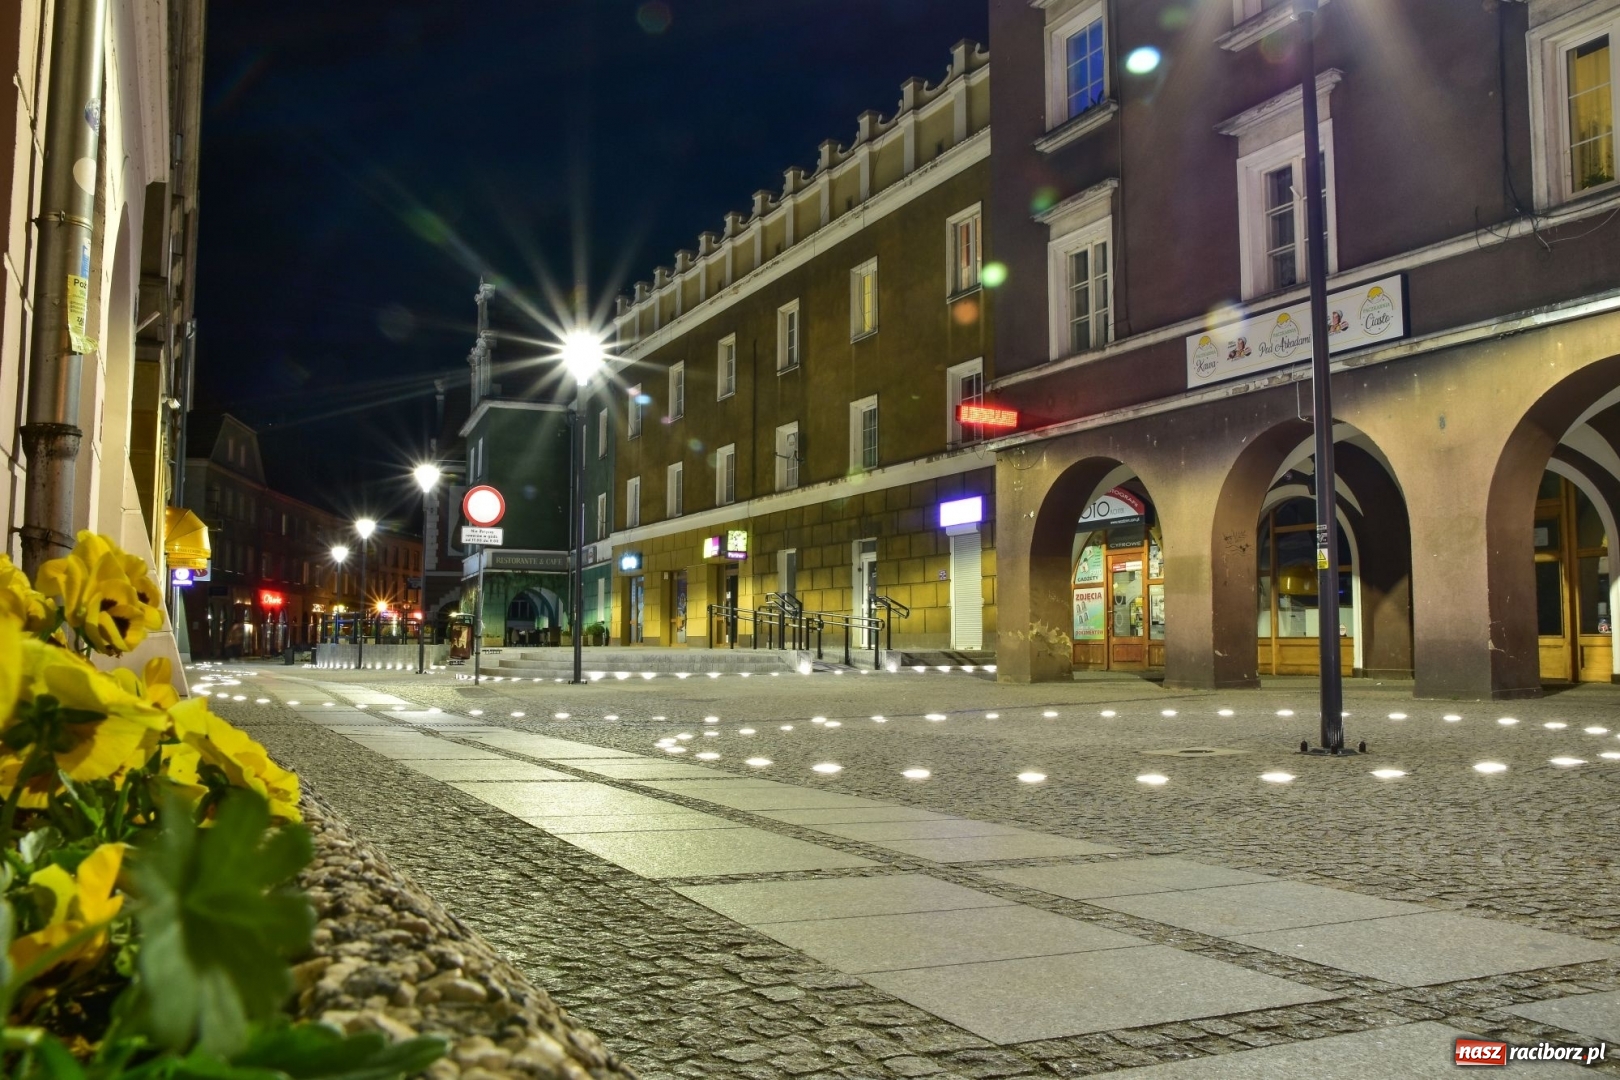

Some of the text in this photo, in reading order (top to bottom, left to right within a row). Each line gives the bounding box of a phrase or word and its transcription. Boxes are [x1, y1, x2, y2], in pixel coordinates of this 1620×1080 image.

[1365, 313, 1390, 329] Ciasto
[1259, 334, 1311, 357] Pod Arkadami
[1195, 359, 1216, 373] Kawa
[495, 556, 536, 565] RISTORANTE
[1075, 592, 1102, 602] ZDJĘCIA
